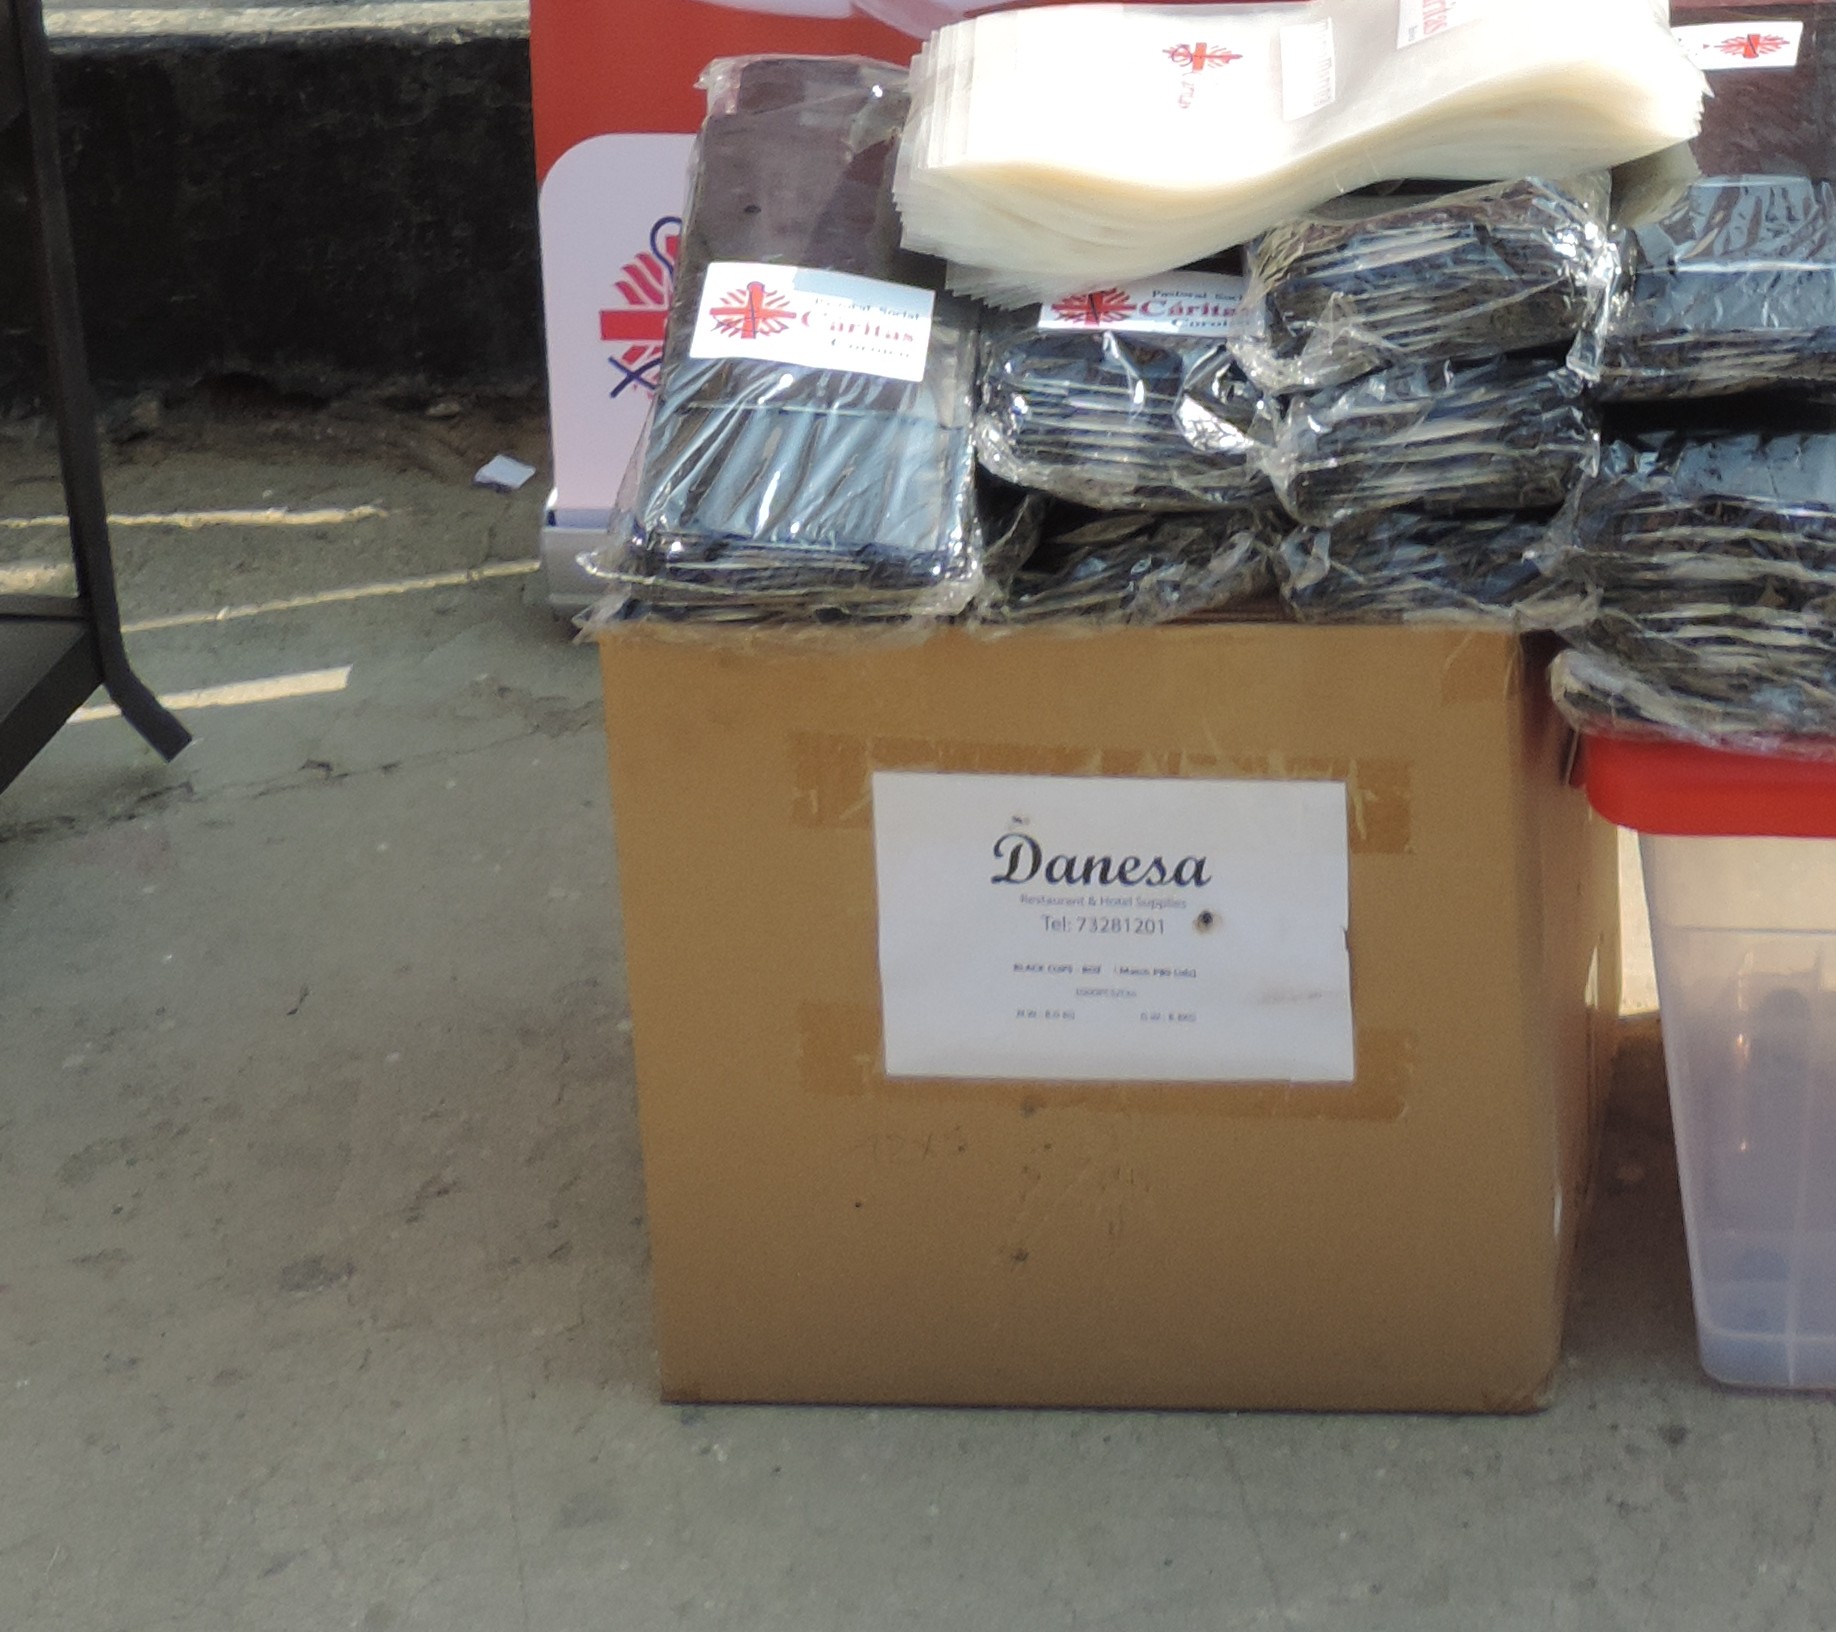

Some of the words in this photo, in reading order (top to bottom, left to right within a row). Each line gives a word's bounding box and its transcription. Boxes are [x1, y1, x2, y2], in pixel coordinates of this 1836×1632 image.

[990, 832, 1212, 887] Danesa
[1041, 914, 1072, 933] Tel:
[1076, 915, 1166, 935] 73281201
